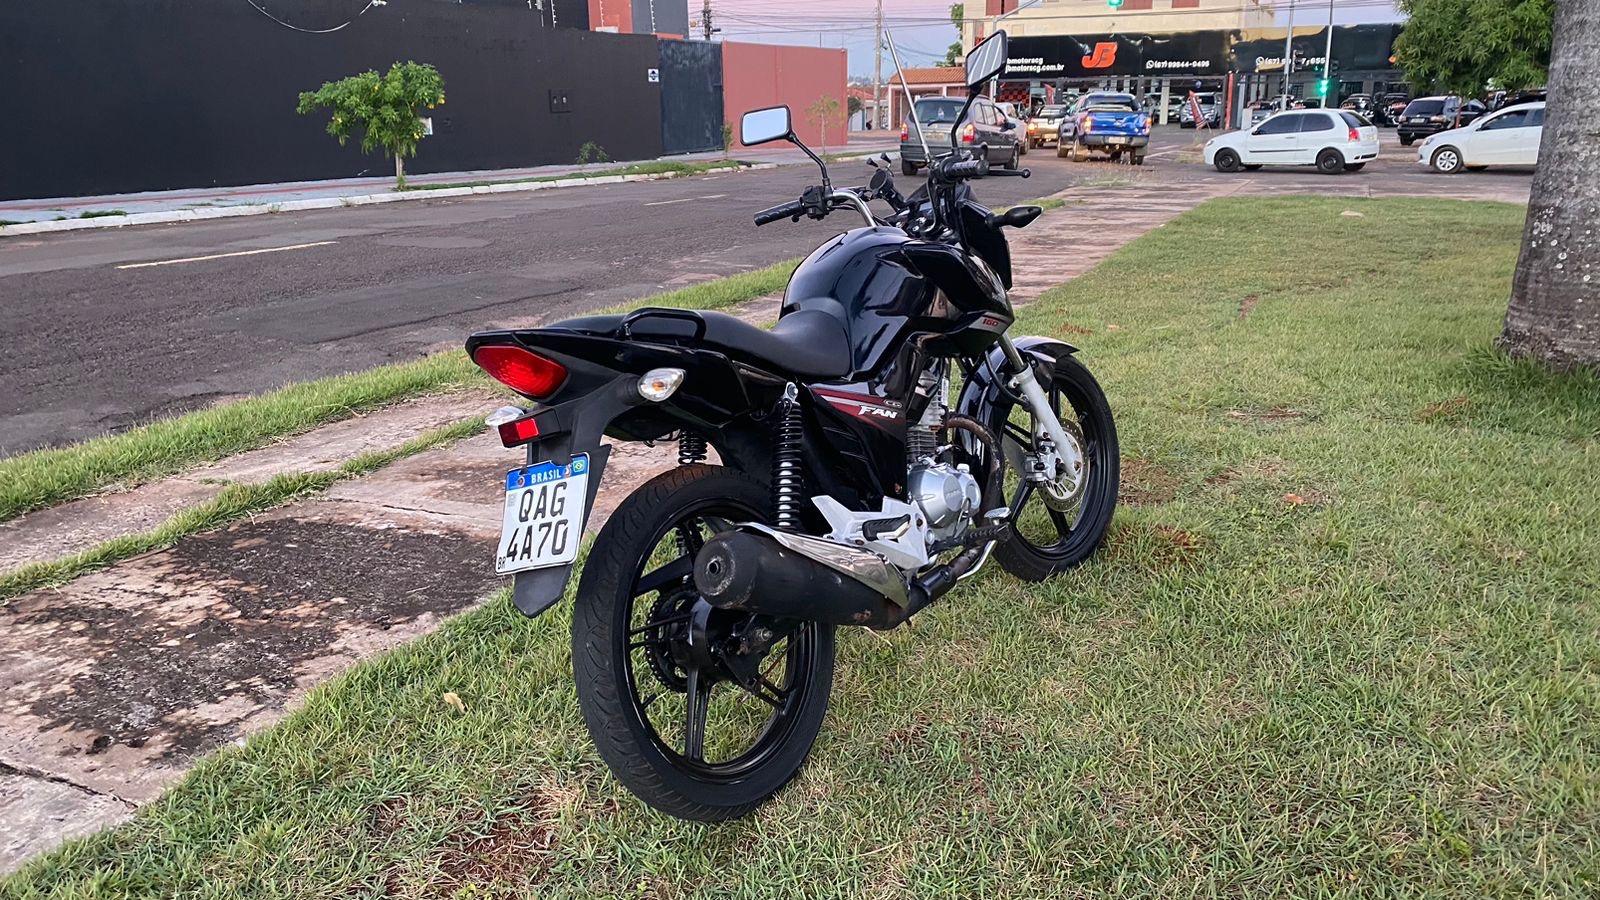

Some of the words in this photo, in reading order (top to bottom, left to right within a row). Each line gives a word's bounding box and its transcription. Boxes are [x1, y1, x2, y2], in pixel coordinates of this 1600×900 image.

[1081, 42, 1118, 69] JB
[858, 404, 898, 419] FAN
[531, 468, 562, 484] BRASIL
[519, 481, 568, 523] QAG
[506, 519, 569, 562] 4A70
